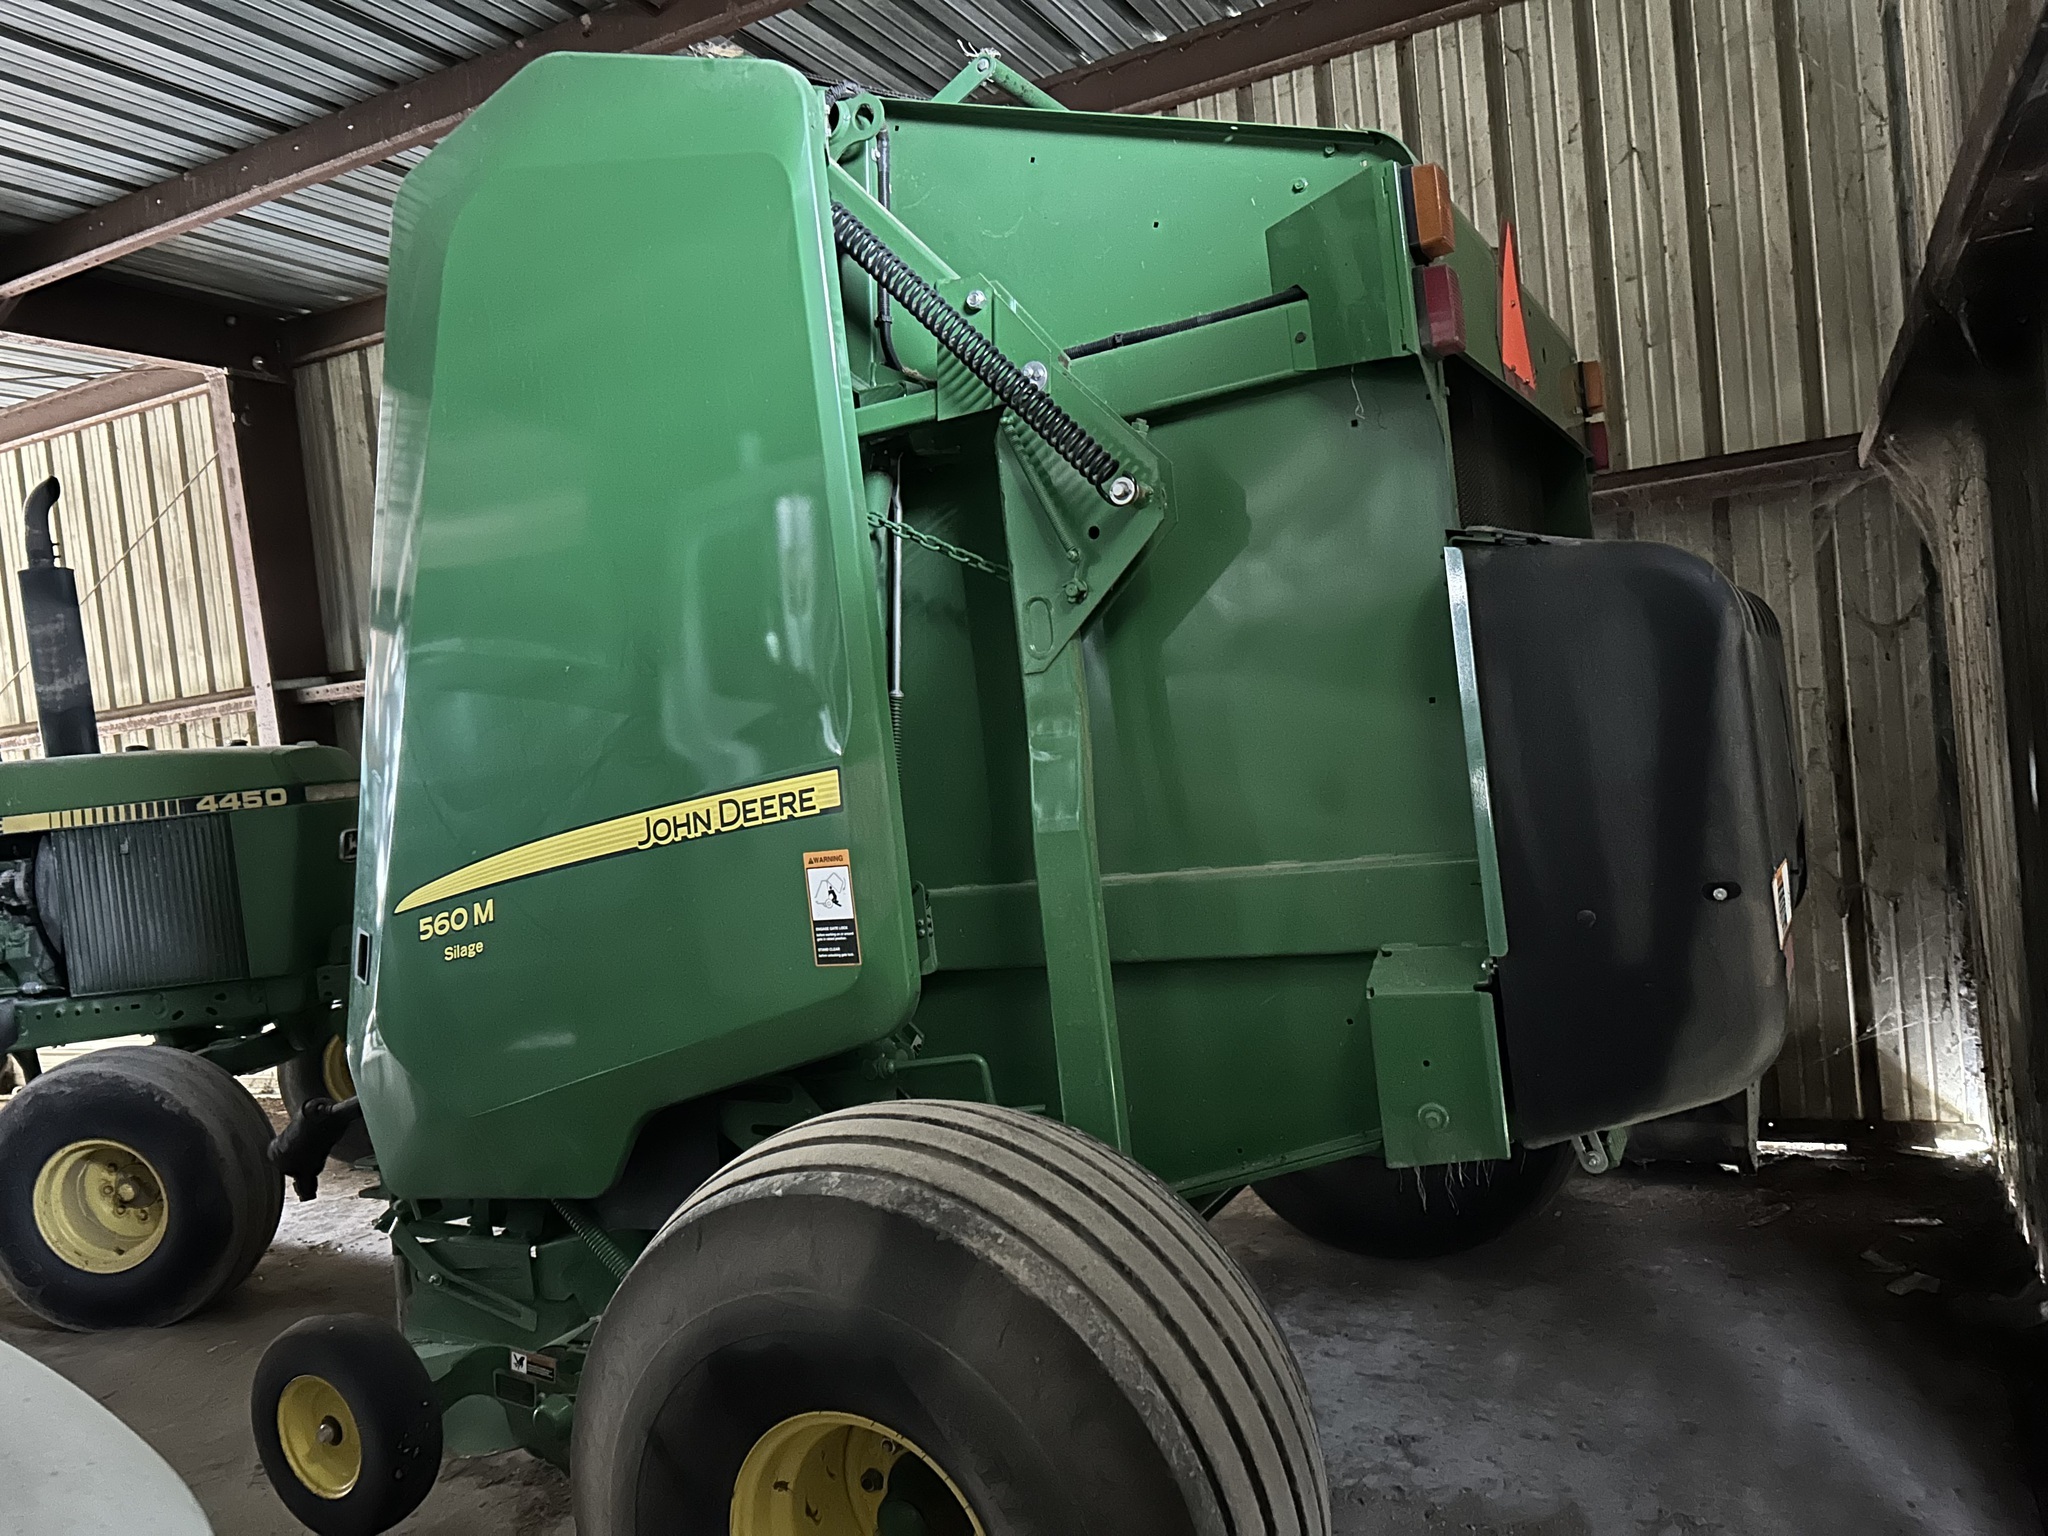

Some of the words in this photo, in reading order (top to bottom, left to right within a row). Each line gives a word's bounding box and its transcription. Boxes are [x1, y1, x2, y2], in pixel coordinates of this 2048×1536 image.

[196, 787, 288, 812] 4450
[637, 808, 712, 846] JOHN
[718, 787, 816, 829] DEERE
[813, 854, 844, 863] WARNING
[419, 907, 469, 941] 560
[473, 898, 494, 926] M
[444, 941, 484, 961] Silage
